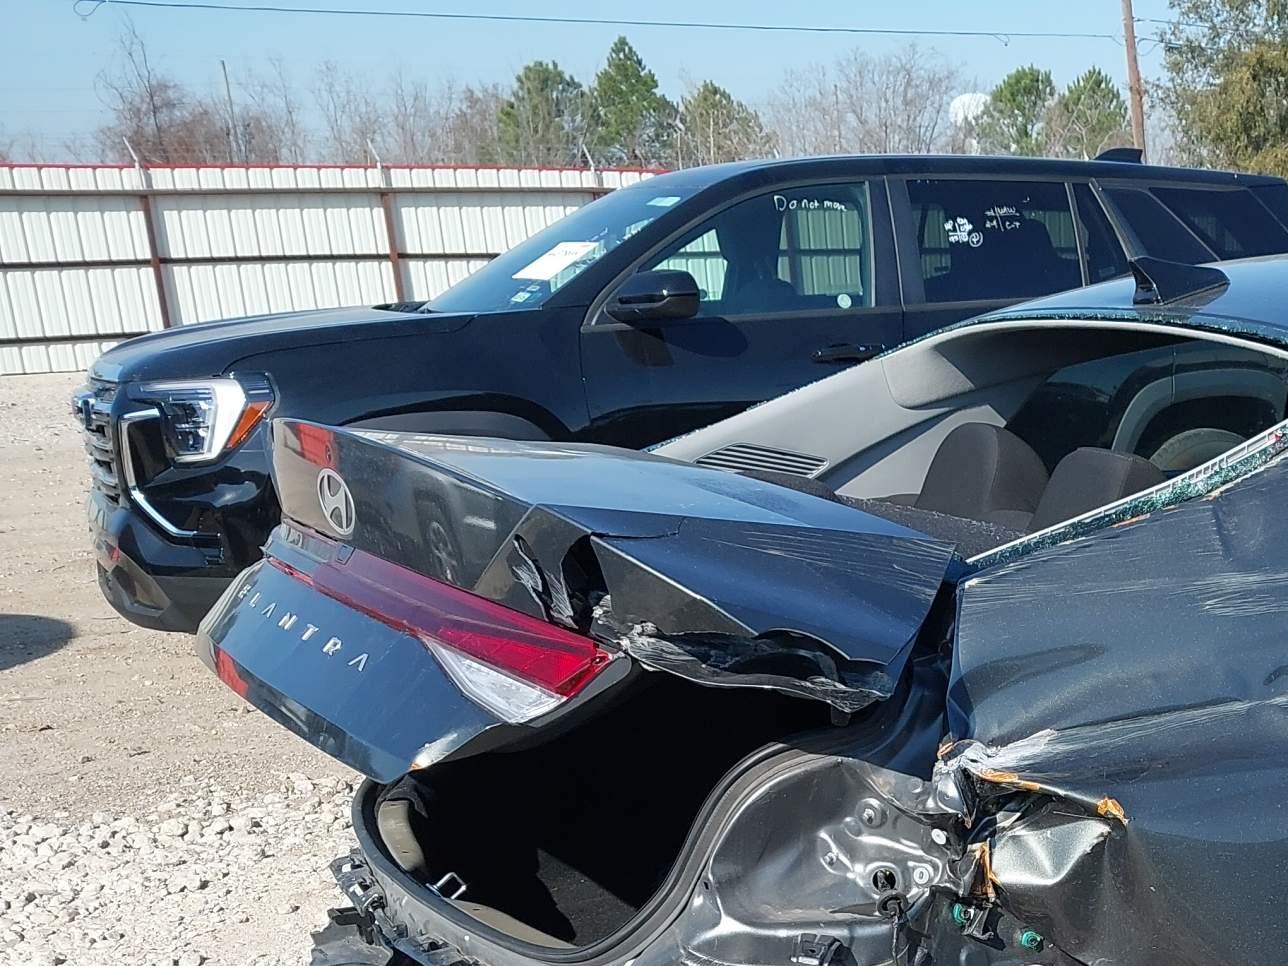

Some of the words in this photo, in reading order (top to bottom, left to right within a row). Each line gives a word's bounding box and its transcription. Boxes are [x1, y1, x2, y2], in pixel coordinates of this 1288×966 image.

[774, 195, 798, 211] Do
[801, 199, 819, 209] not
[238, 584, 369, 672] ELANTRA
